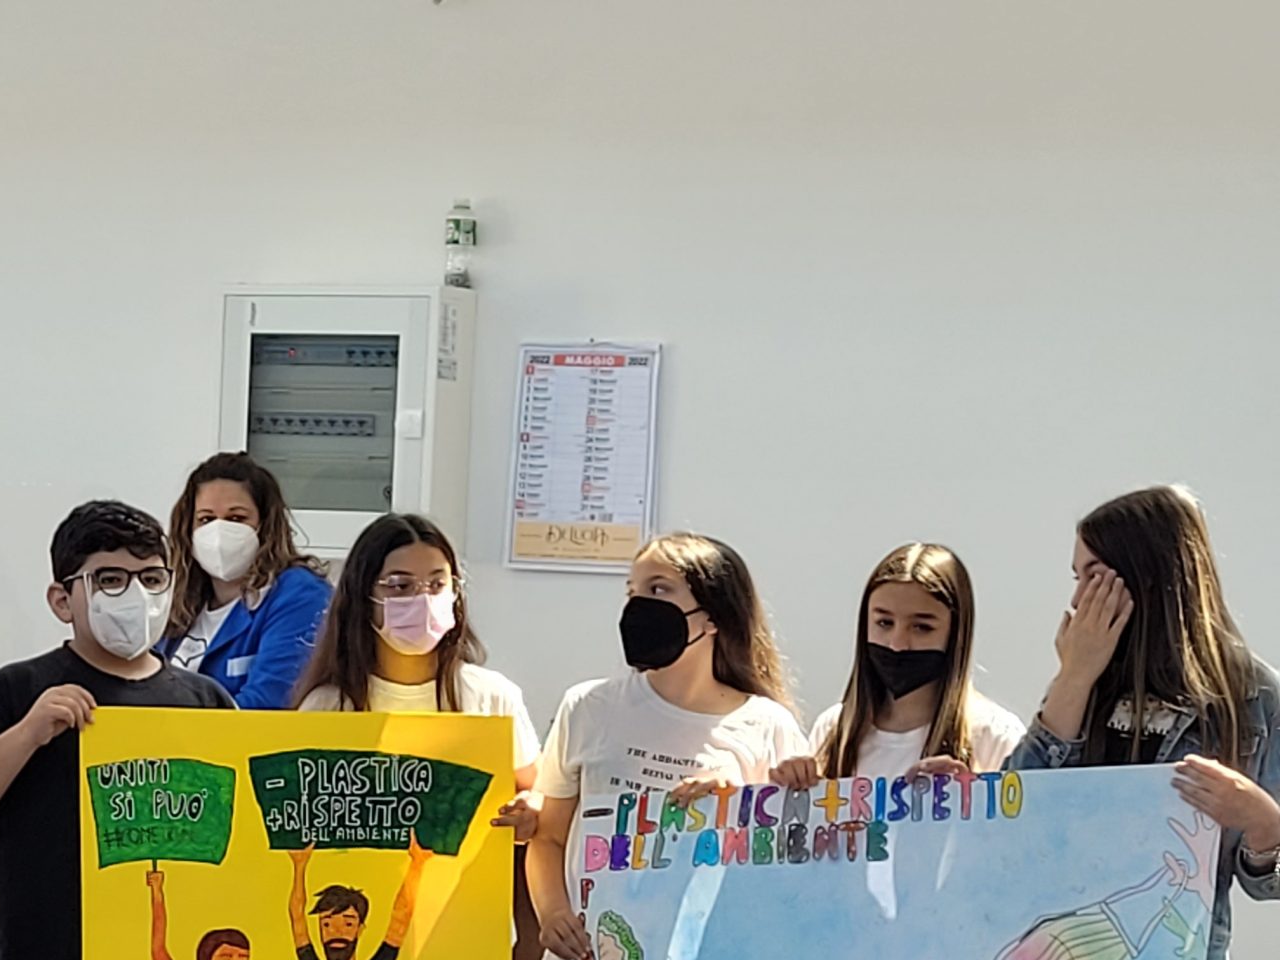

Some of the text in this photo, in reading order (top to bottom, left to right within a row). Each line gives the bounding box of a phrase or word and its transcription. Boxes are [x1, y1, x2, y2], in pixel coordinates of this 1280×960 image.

[564, 355, 616, 366] MAGGIO
[97, 759, 171, 789] UNITI
[298, 756, 433, 795] PLASTICA
[110, 791, 136, 821] SI
[693, 821, 889, 867] AMBIENTE
